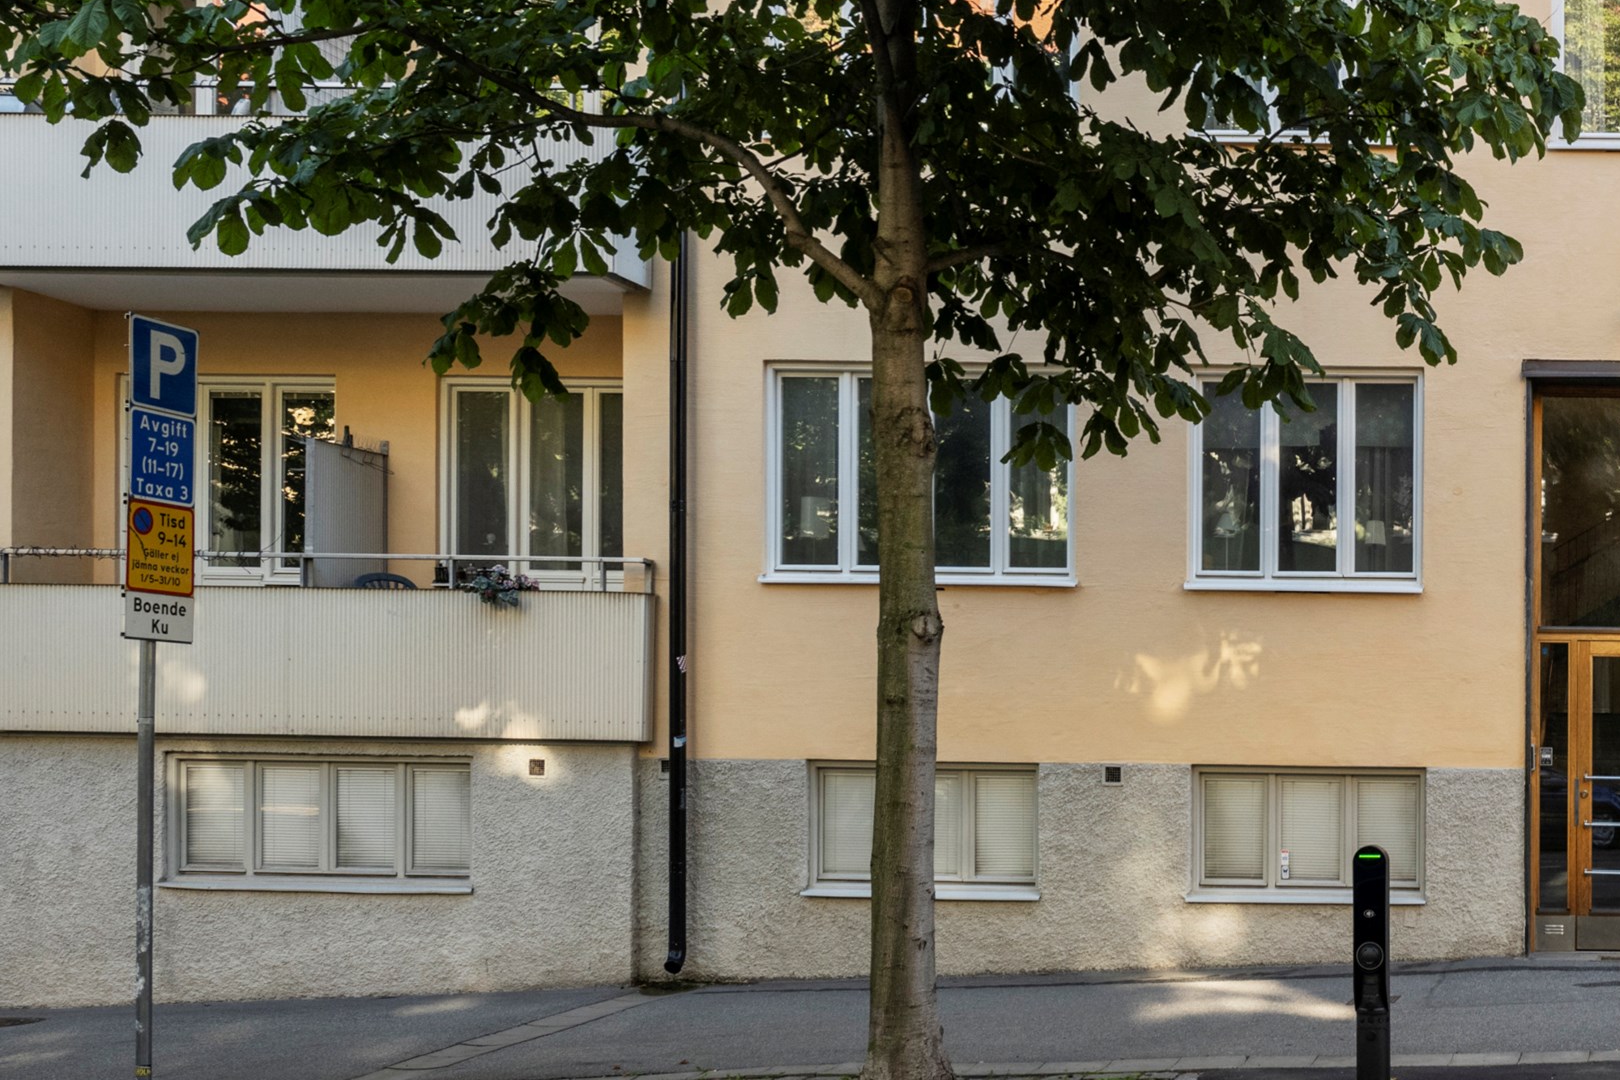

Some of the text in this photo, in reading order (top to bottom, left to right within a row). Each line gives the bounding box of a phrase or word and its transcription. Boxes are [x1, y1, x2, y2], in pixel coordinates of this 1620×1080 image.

[150, 329, 186, 400] P
[140, 414, 187, 439] Avgift
[148, 437, 179, 457] 7-19
[142, 456, 184, 480] (11-17)
[136, 477, 189, 500] Taxa 3
[160, 513, 186, 529] Tisd
[158, 531, 187, 548] 9-14
[144, 548, 179, 563] Gäller ej
[132, 558, 189, 575] jämna veckor
[140, 573, 181, 586] 1/5-31/10
[133, 597, 187, 617] Boende
[151, 619, 169, 634] Ku
